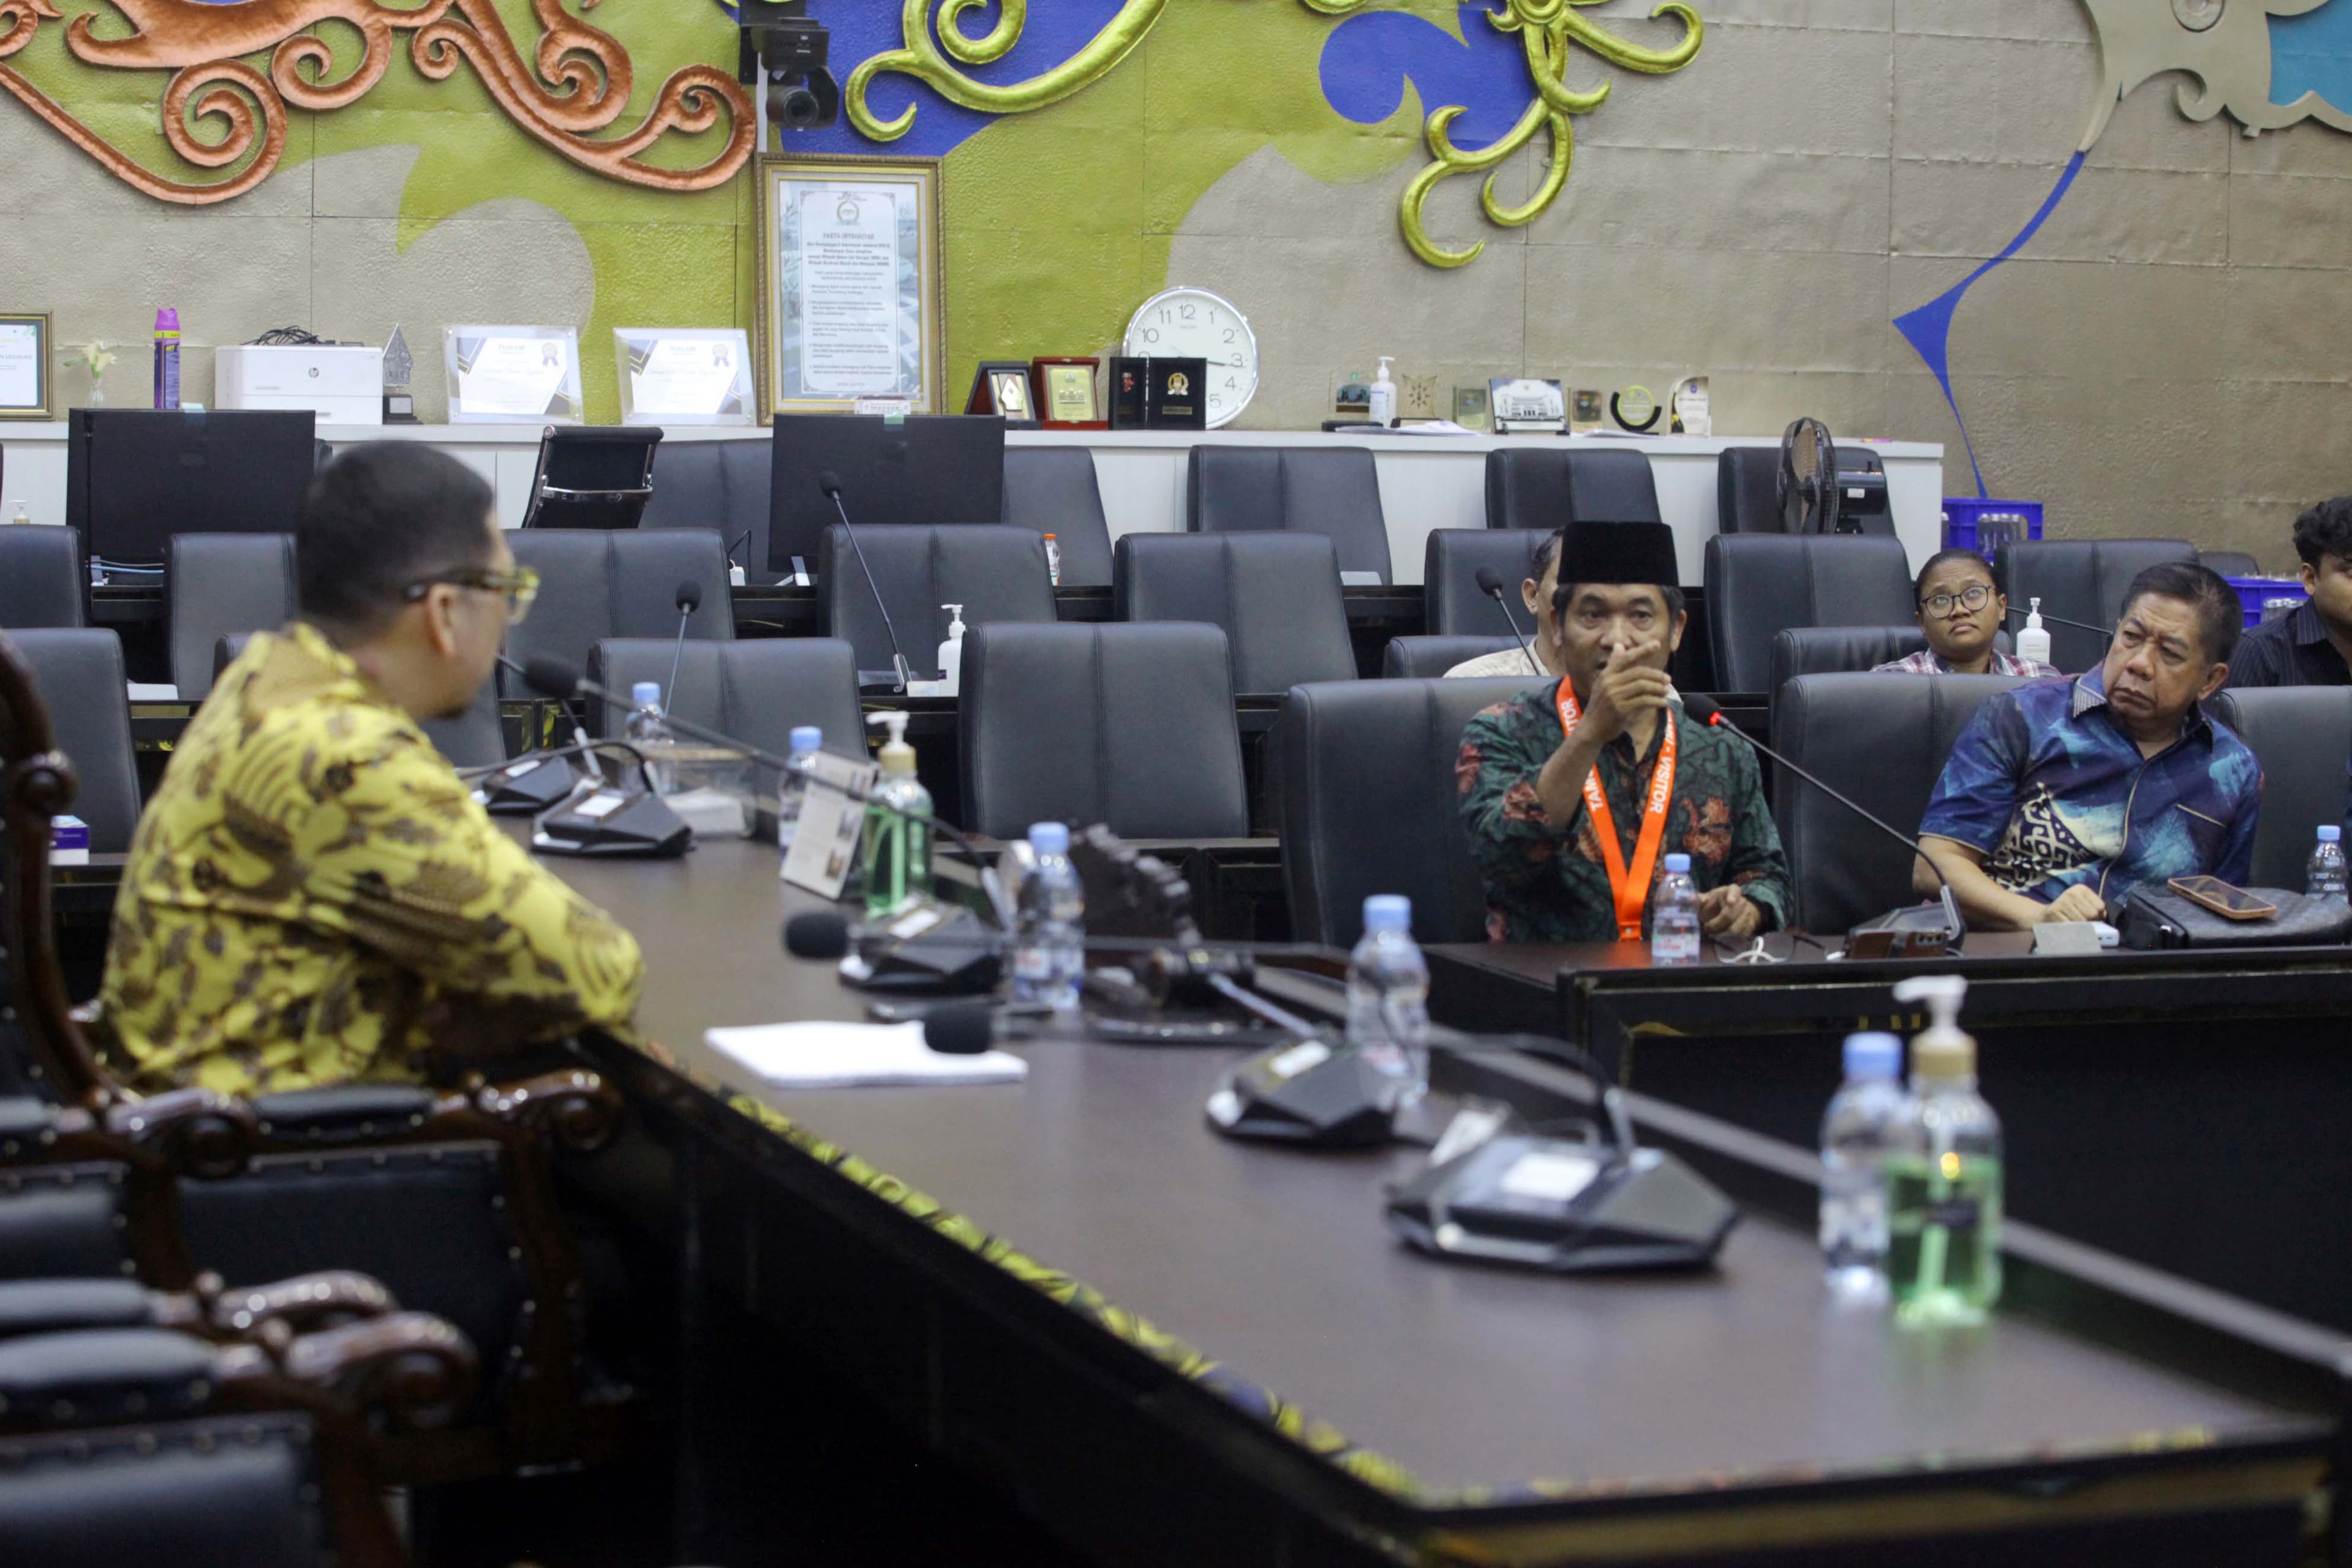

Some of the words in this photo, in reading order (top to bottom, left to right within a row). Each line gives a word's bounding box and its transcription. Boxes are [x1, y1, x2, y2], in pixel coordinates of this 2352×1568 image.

[1159, 309, 1171, 325] 11
[1179, 304, 1196, 320] 12
[1208, 310, 1215, 325] 1
[1142, 328, 1159, 344] 10
[1223, 328, 1235, 344] 2
[1231, 352, 1243, 368] 3
[1224, 376, 1237, 391] 4
[1209, 394, 1221, 409] 5
[1584, 769, 1604, 812] TAM
[1649, 756, 1673, 814] VISITOR
